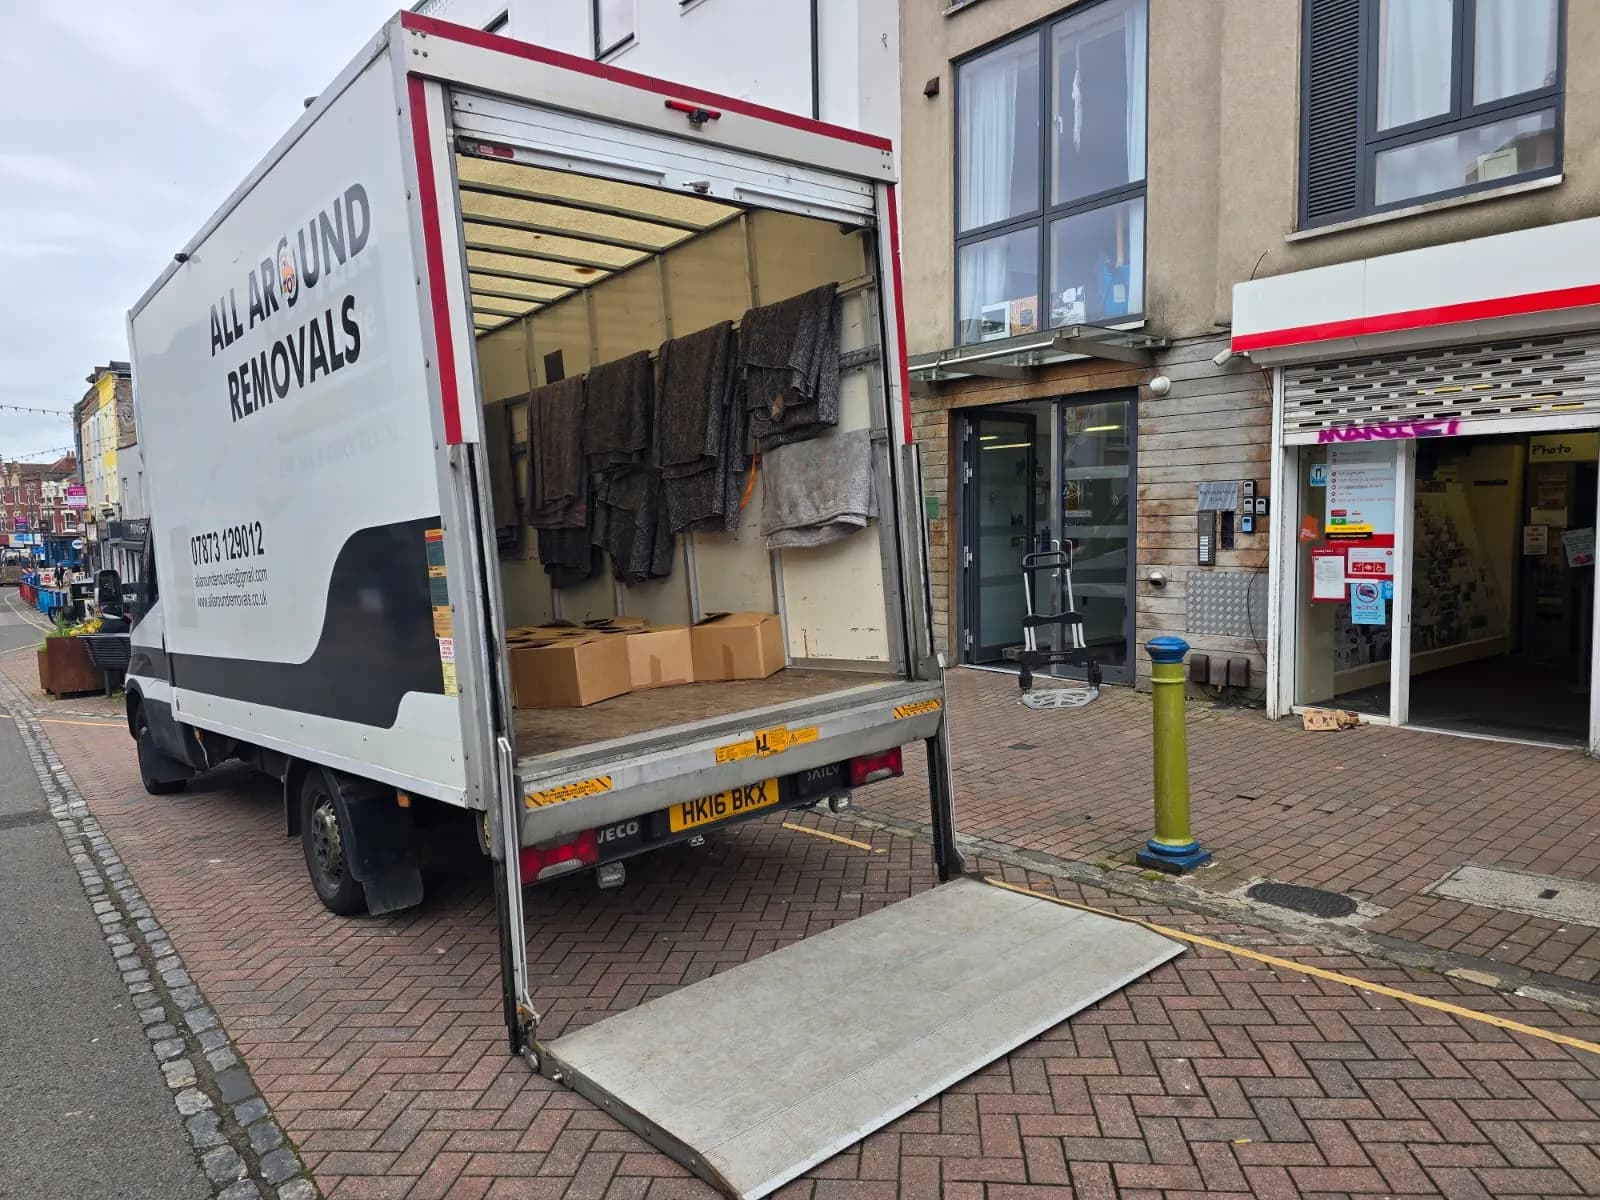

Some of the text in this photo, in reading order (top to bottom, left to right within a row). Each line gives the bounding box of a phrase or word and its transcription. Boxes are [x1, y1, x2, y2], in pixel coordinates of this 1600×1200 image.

[209, 287, 244, 358] ALL
[249, 183, 371, 330] AROUND
[227, 294, 361, 423] REMOVALS
[1532, 442, 1572, 456] Photo
[191, 521, 265, 566] 07873 129012
[682, 779, 768, 825] HK16 BKX
